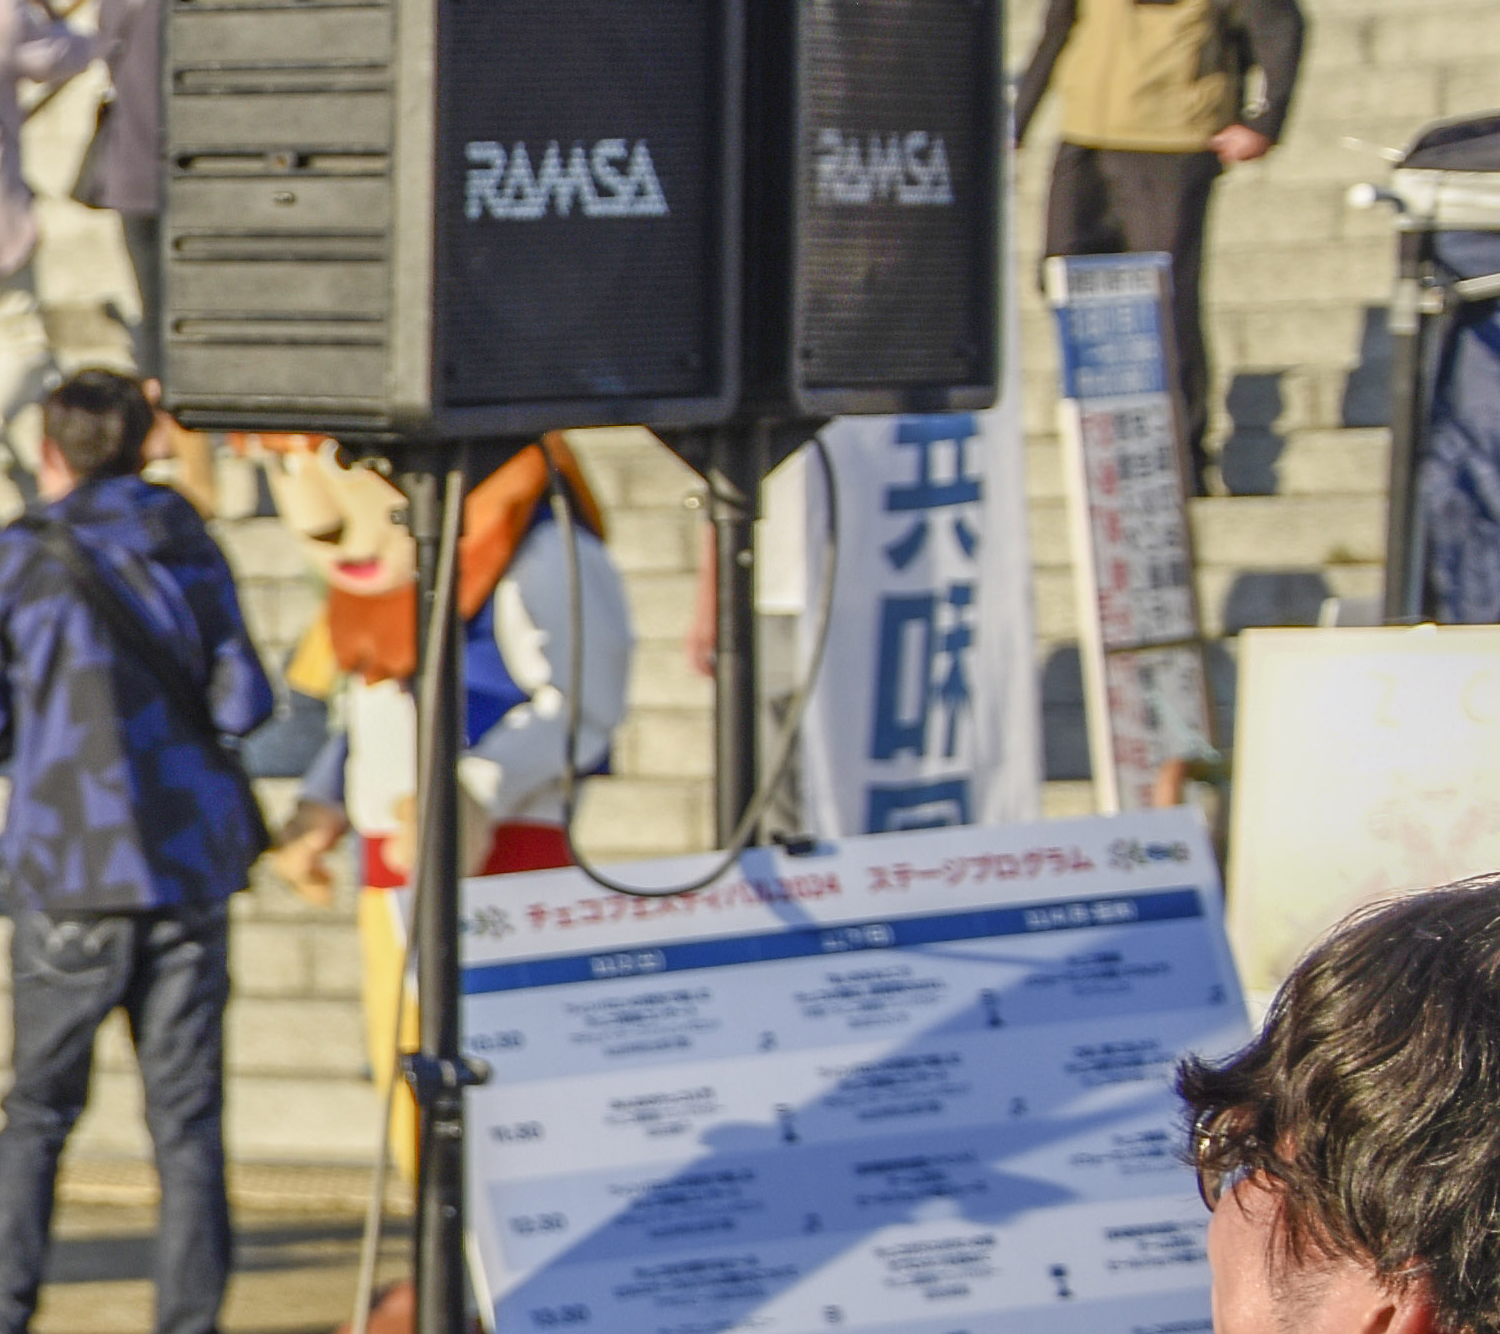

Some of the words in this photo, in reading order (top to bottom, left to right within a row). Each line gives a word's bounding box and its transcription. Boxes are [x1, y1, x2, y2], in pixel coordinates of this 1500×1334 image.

[465, 138, 669, 221] RAMSA
[814, 128, 955, 206] RAMSA
[866, 844, 1096, 893] ステージプログラム
